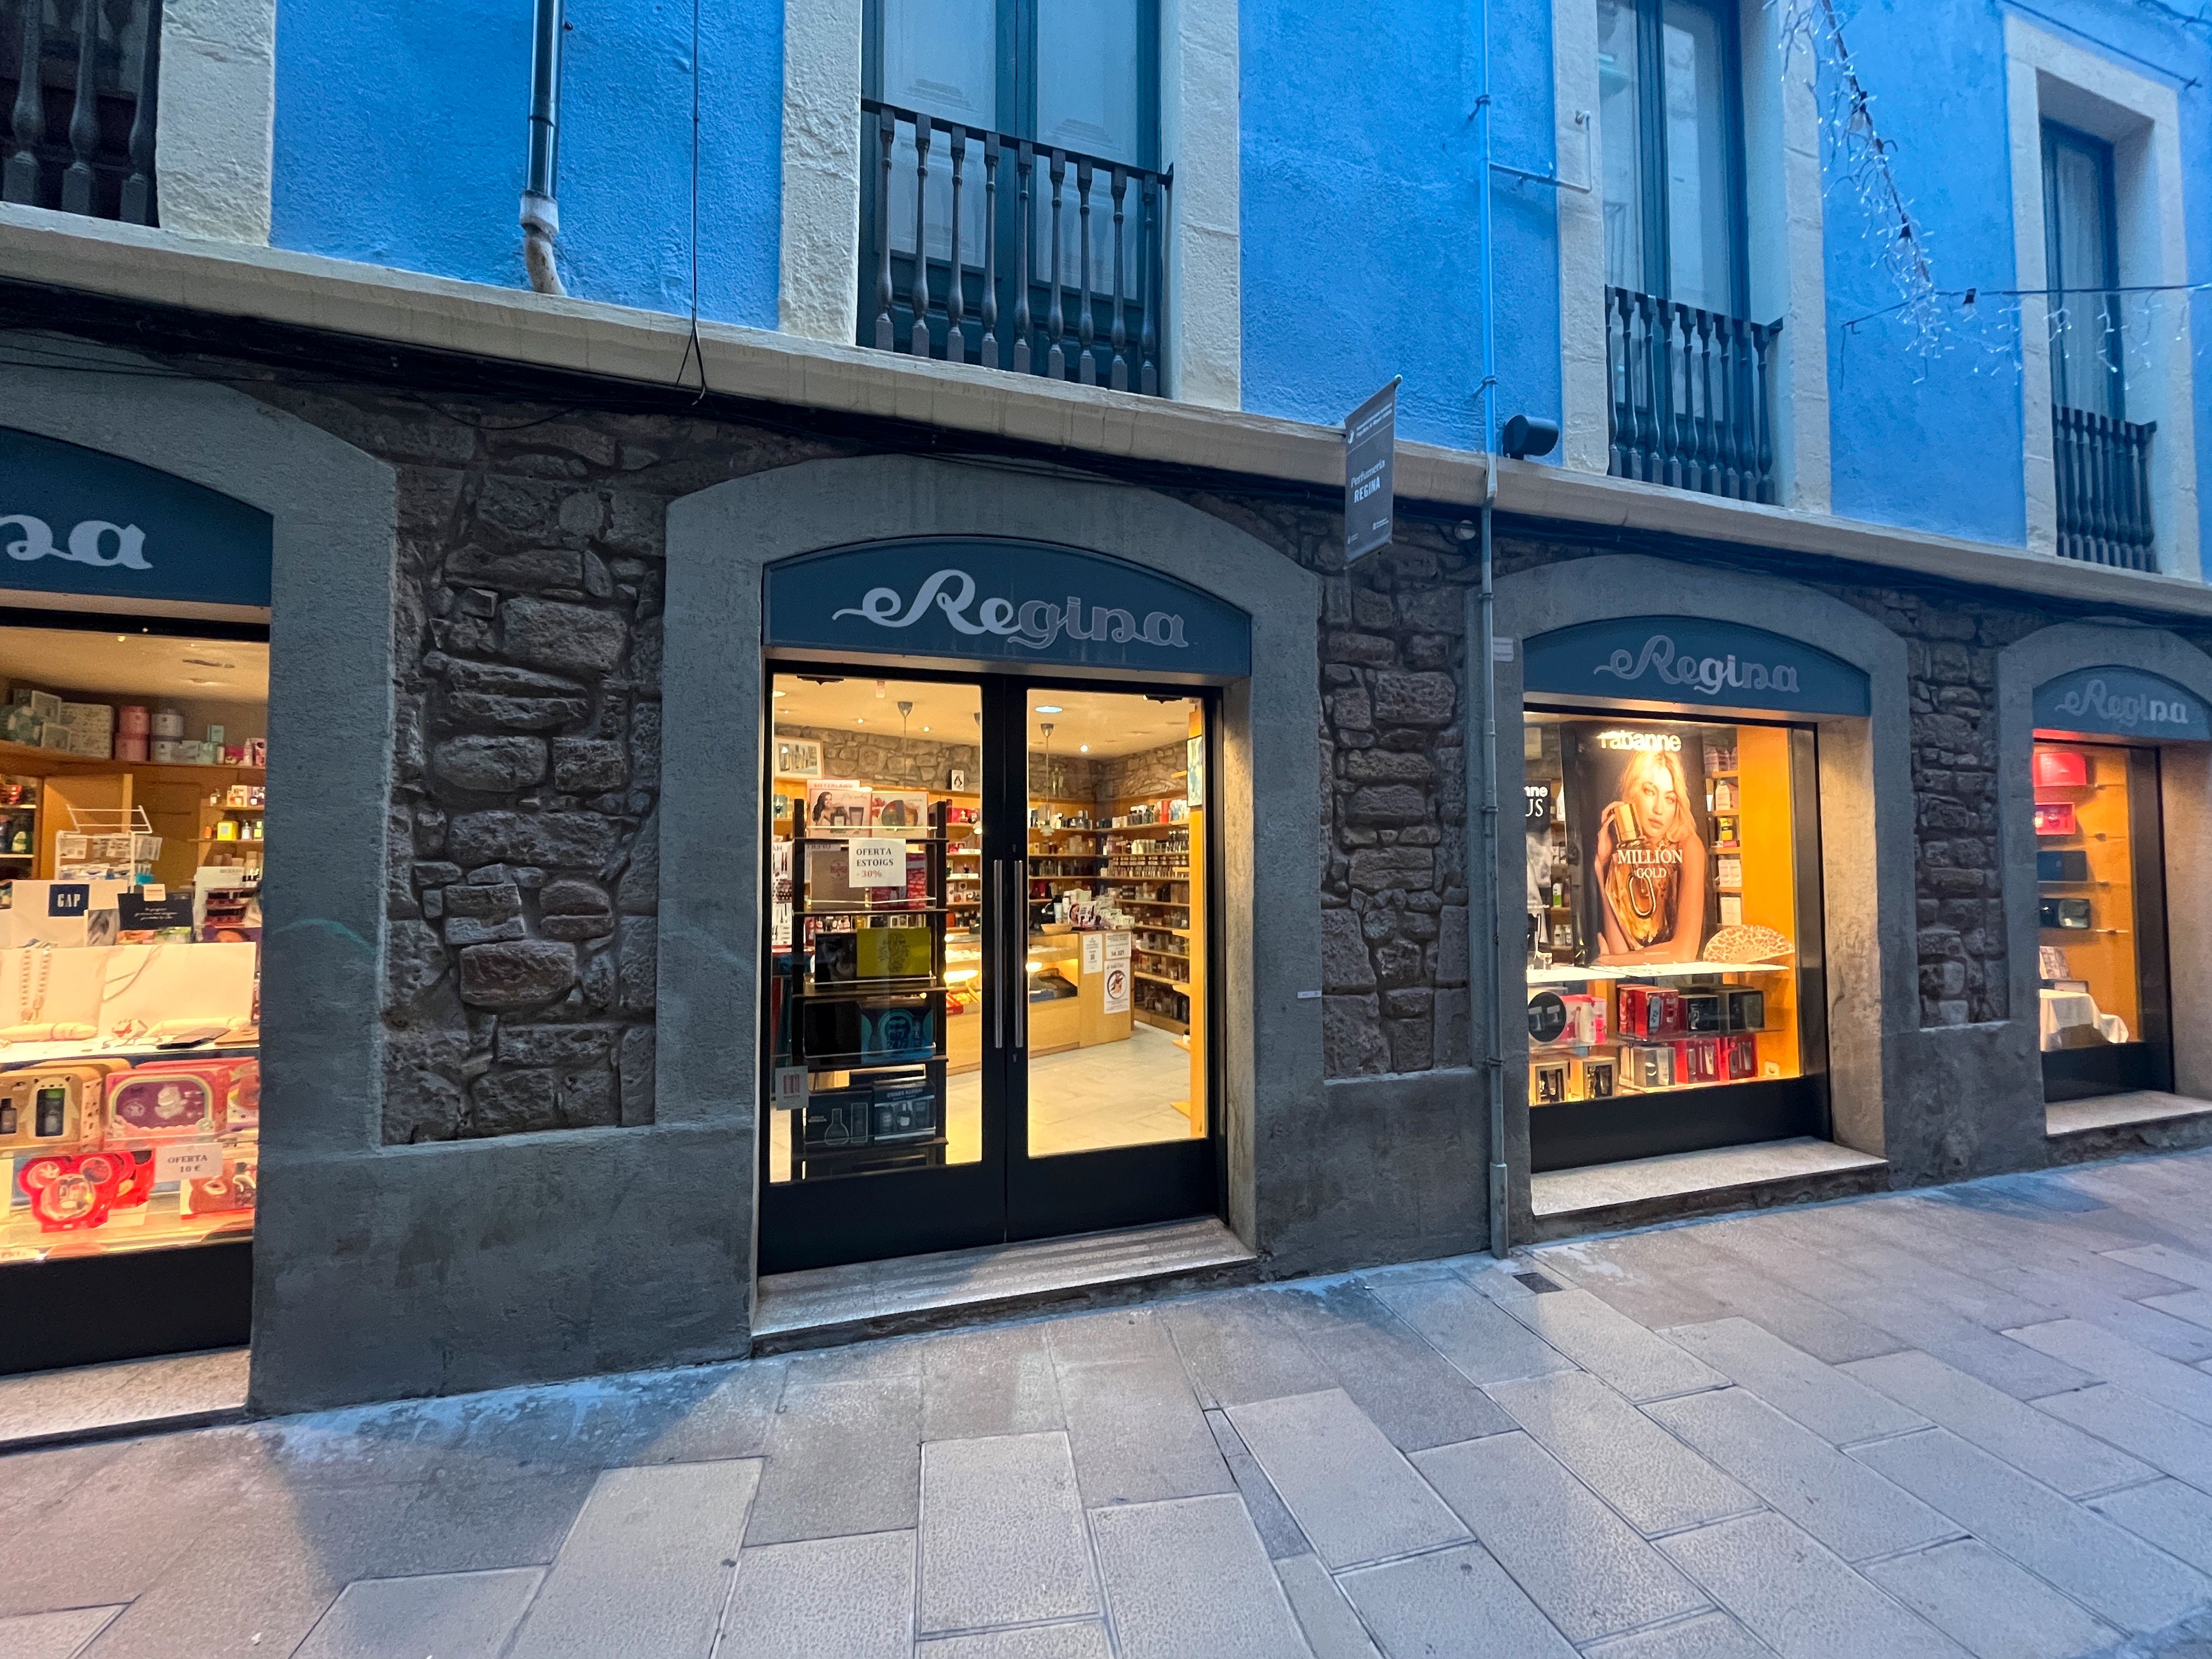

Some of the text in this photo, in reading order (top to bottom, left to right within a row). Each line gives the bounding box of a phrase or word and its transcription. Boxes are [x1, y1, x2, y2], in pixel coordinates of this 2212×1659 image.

[1354, 476, 1380, 503] REGINA
[831, 569, 1189, 649] Regina
[1594, 635, 1800, 695] Regina
[2054, 679, 2189, 727] Regina
[1600, 730, 1681, 752] rabanne
[1617, 849, 1683, 864] MILLION
[1636, 867, 1667, 878] GOLD
[57, 894, 81, 907] GAP
[167, 1154, 208, 1164] OFERTA
